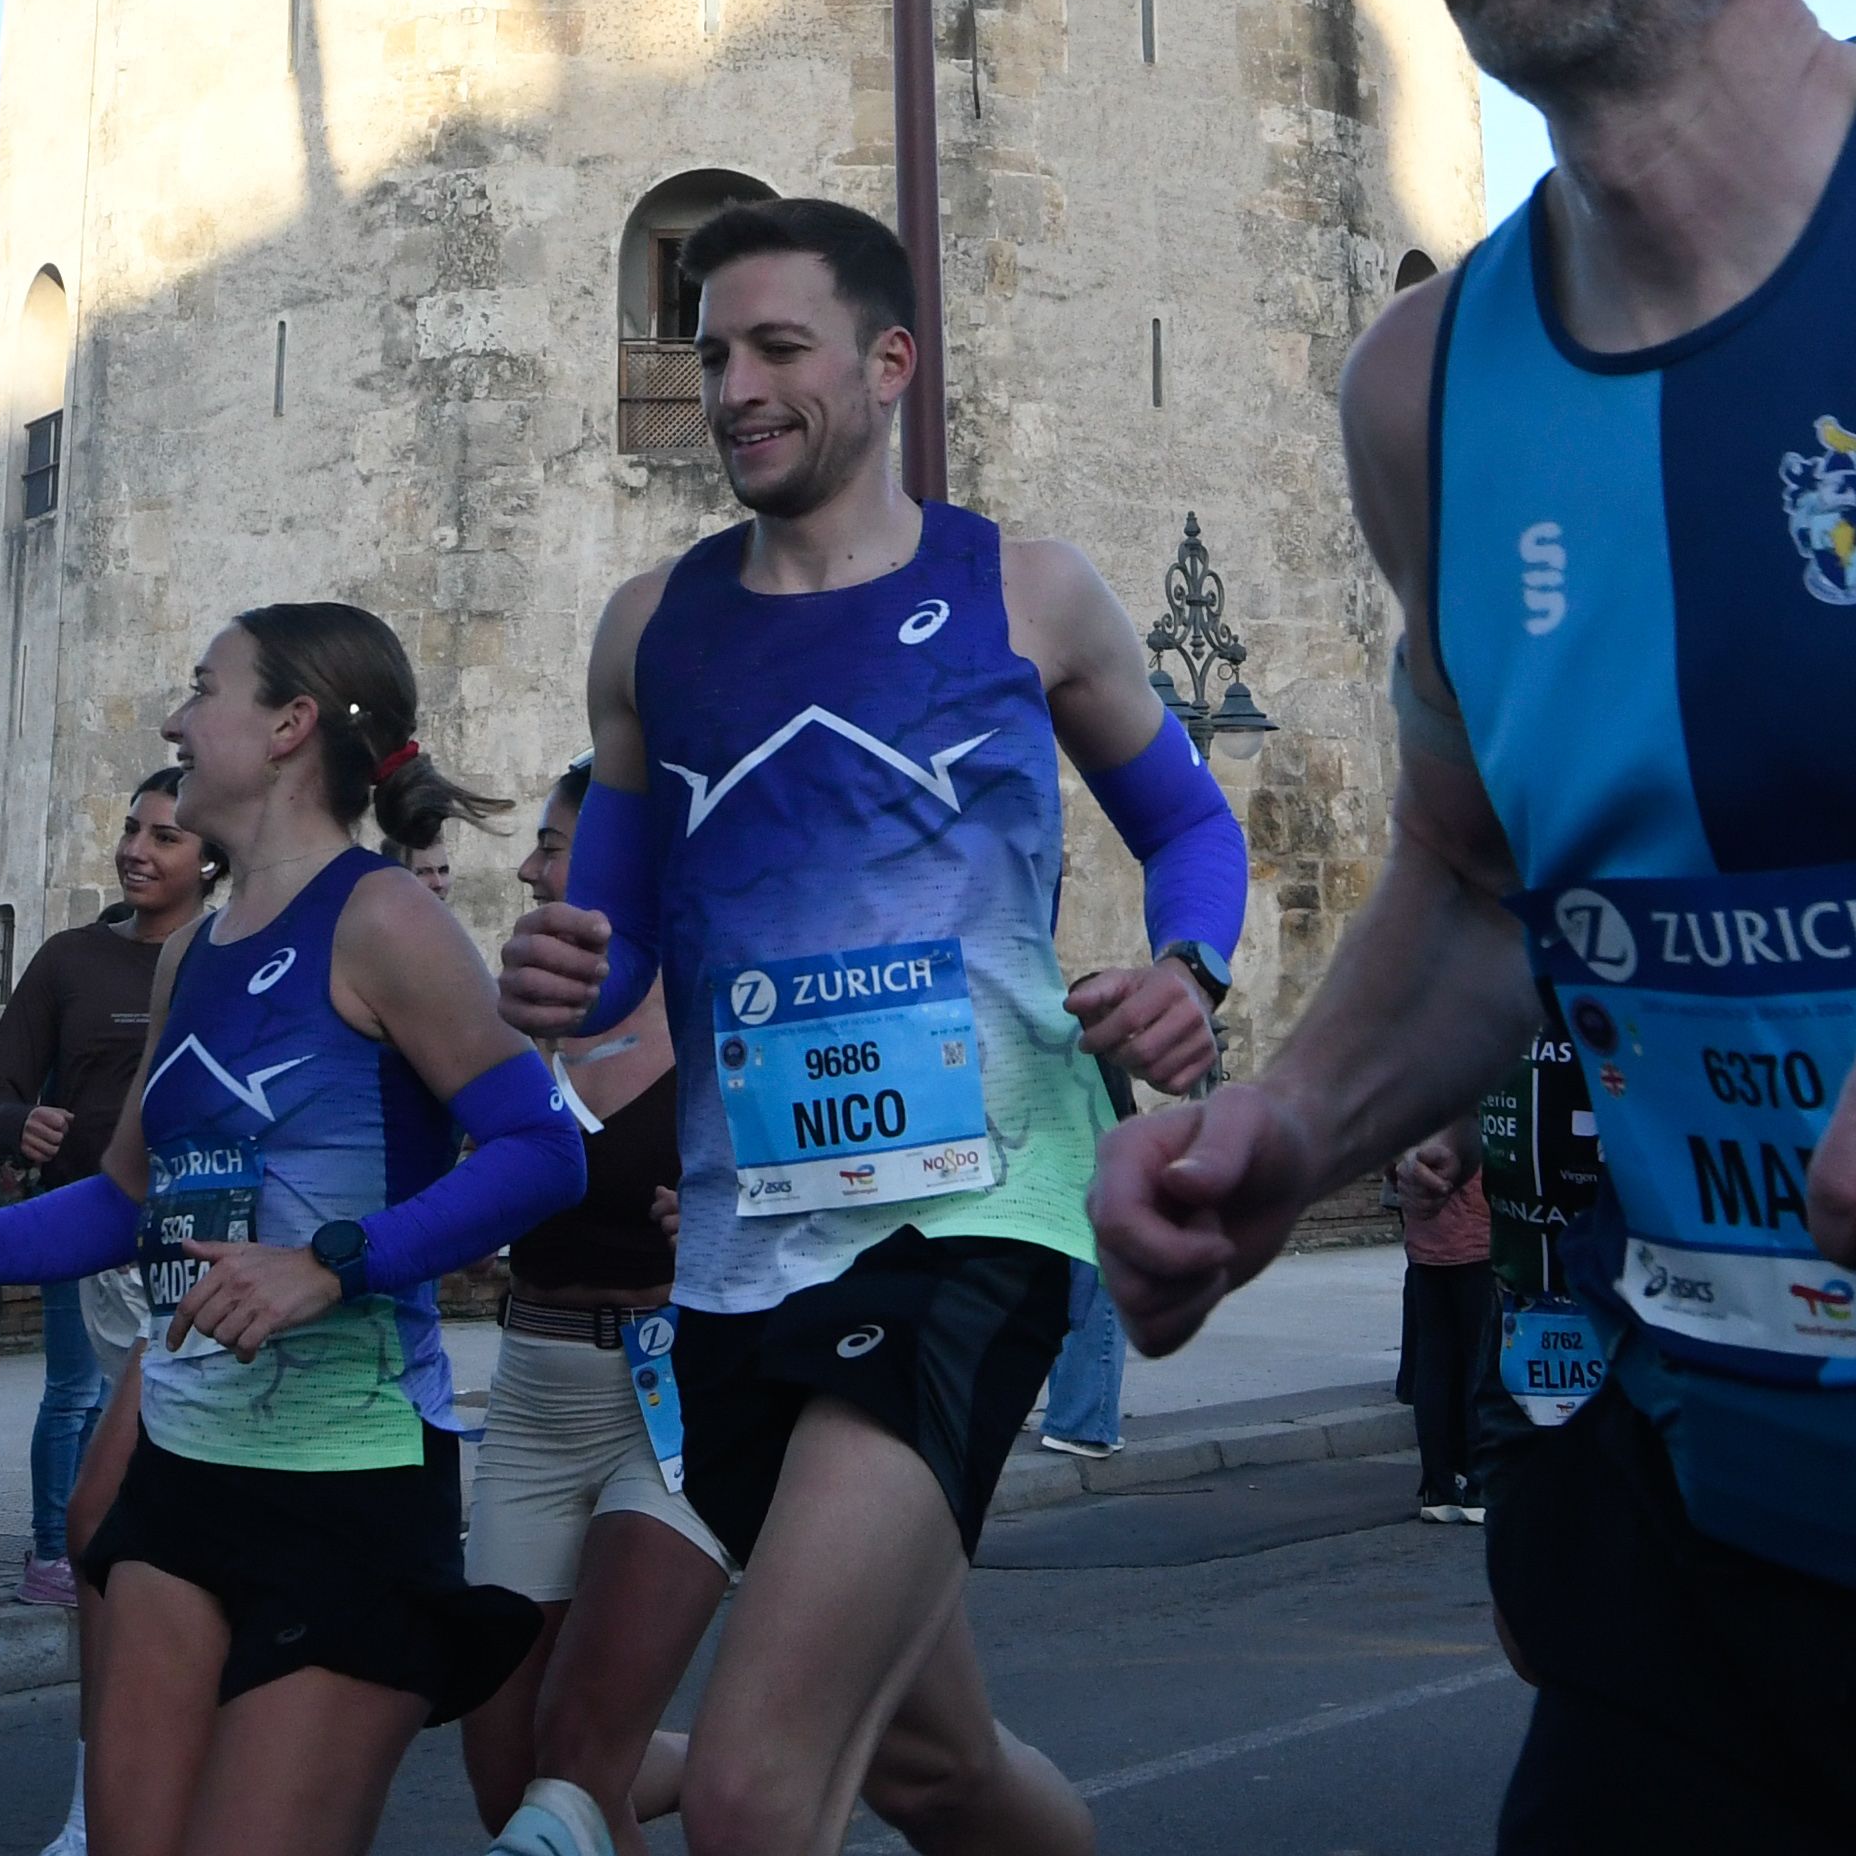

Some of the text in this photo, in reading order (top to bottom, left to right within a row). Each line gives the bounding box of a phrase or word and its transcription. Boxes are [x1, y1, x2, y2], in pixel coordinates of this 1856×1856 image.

[793, 959, 933, 1006] ZURICH
[805, 1041, 881, 1080] 9686
[1701, 1047, 1825, 1110] 6370
[793, 1089, 907, 1149] NICO
[160, 1214, 195, 1245] 5326
[1541, 1331, 1584, 1350] 8762
[1527, 1360, 1605, 1389] ELIAS
